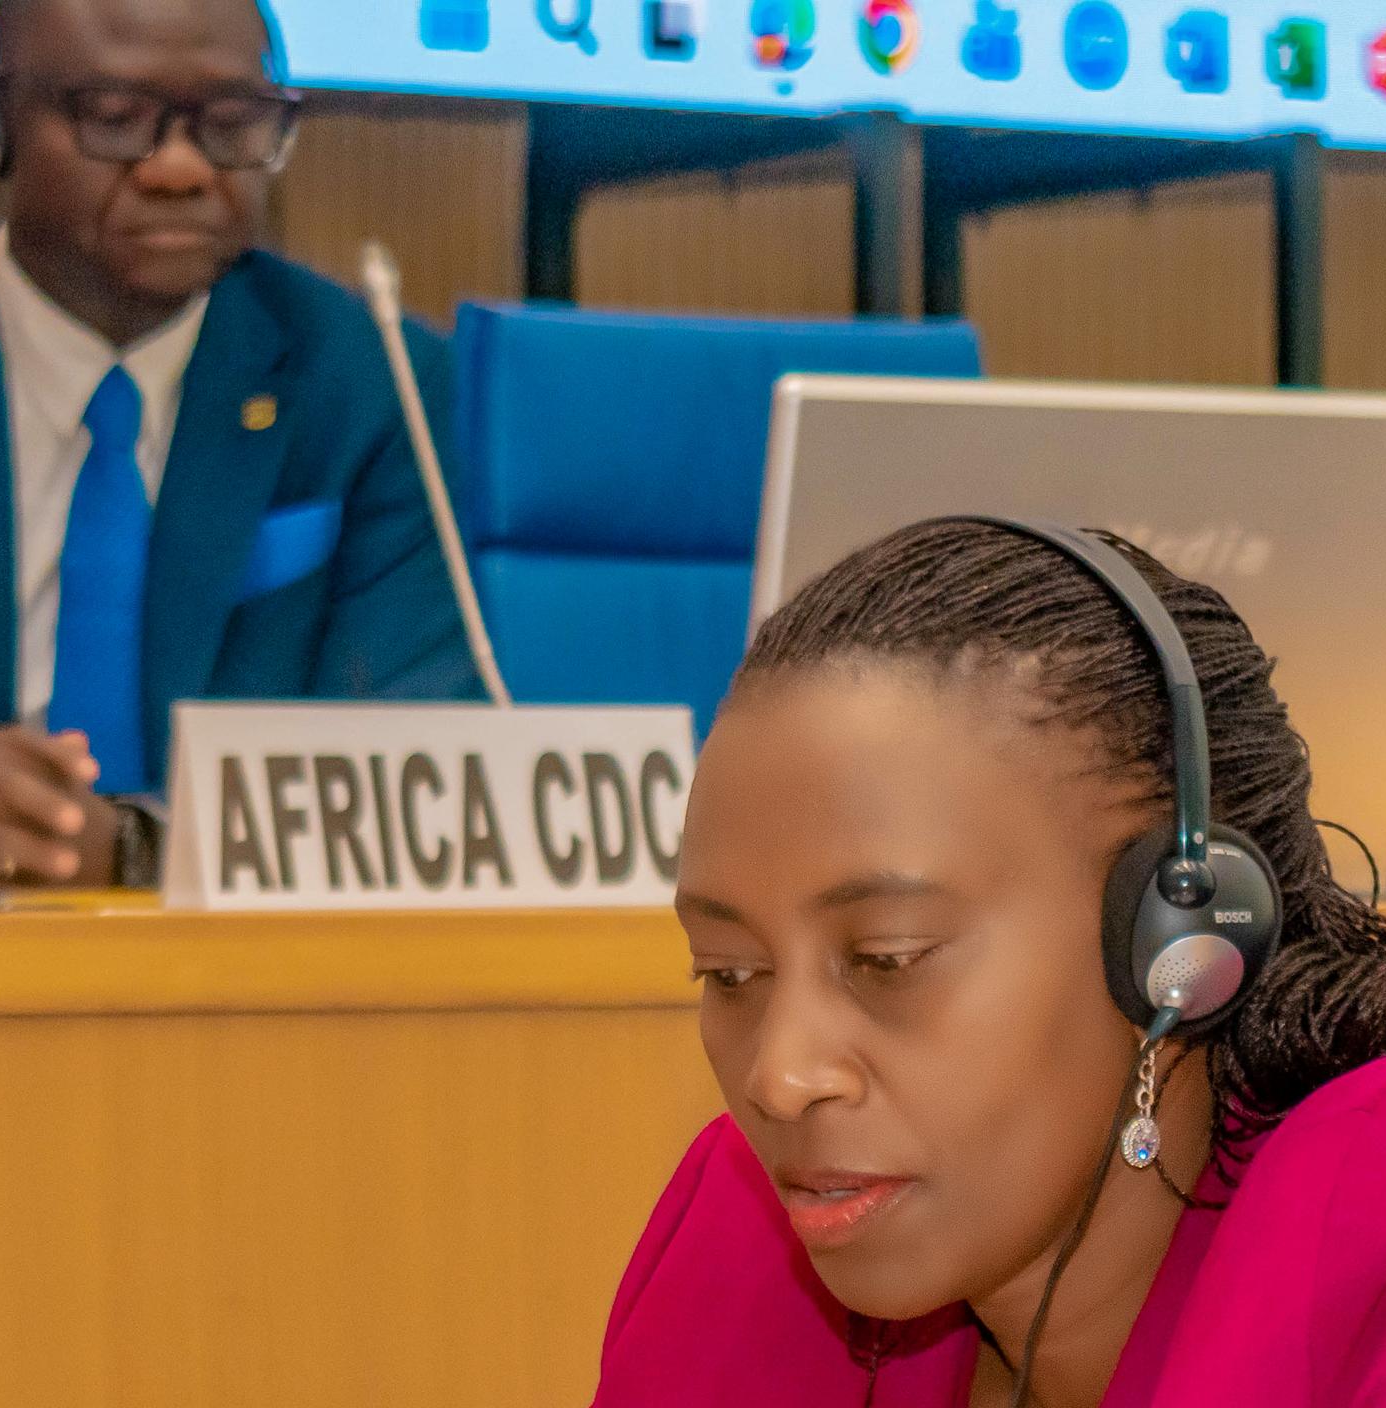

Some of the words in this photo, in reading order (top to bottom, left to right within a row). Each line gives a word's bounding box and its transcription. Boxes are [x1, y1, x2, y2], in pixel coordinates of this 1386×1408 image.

[219, 750, 516, 892] AFRICA
[532, 749, 682, 889] CDC
[1214, 911, 1252, 924] BOSCH
